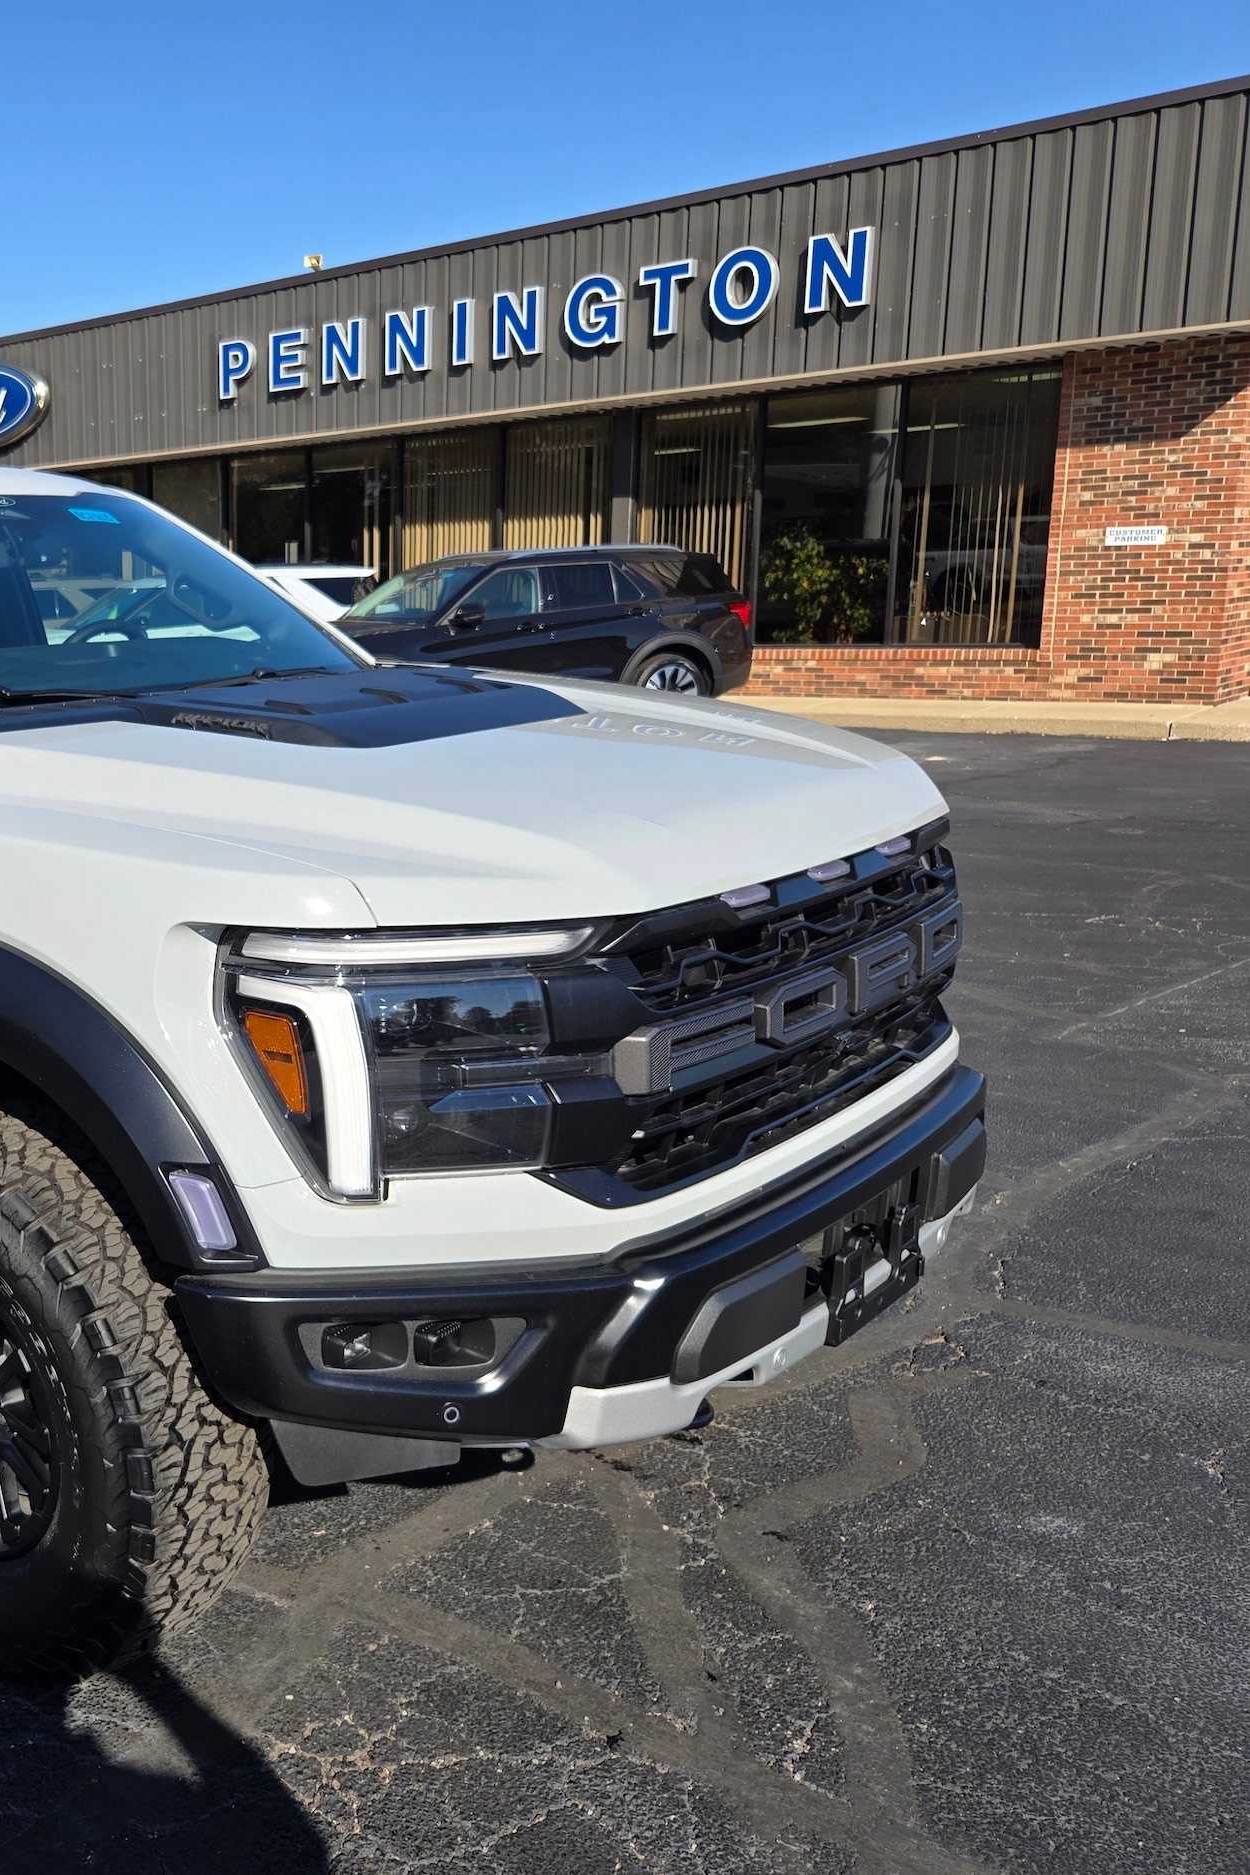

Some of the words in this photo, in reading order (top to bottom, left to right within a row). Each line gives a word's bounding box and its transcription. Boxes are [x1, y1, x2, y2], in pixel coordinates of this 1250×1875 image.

[218, 225, 876, 401] PENNINGTON
[1109, 529, 1164, 537] CUSTOMER
[613, 900, 962, 1096] FORD
